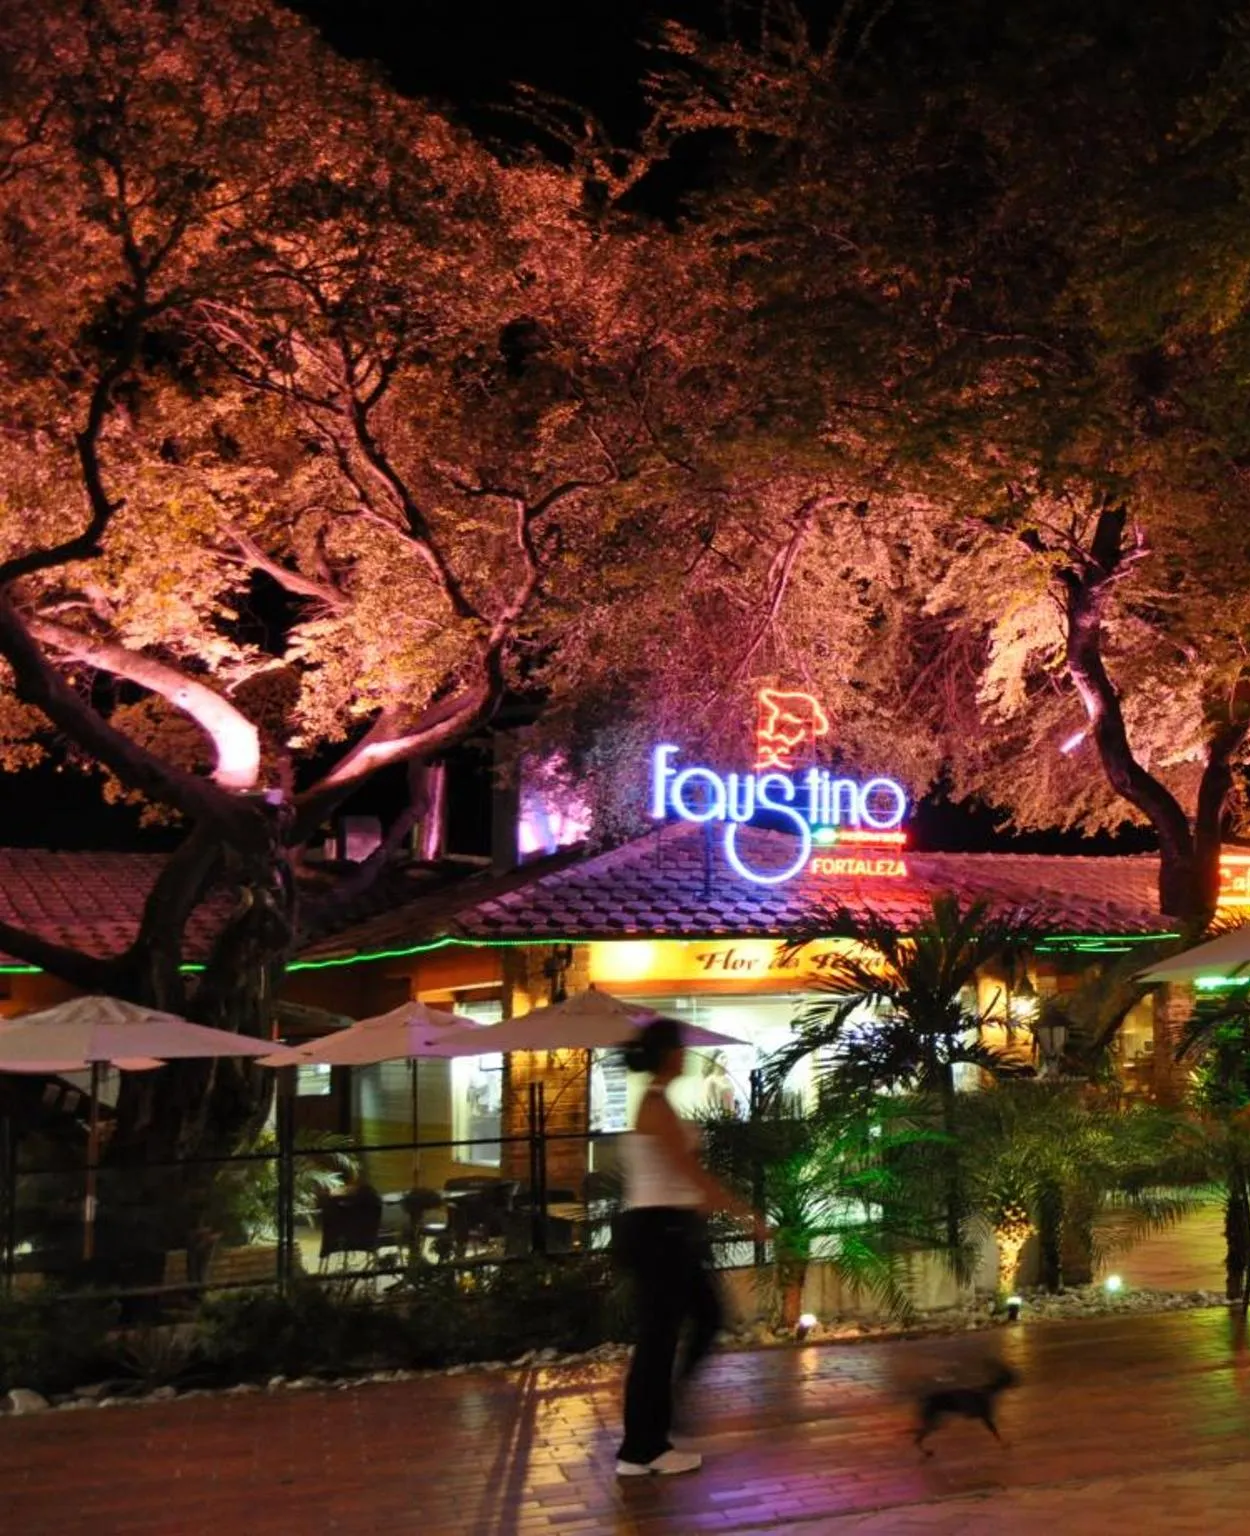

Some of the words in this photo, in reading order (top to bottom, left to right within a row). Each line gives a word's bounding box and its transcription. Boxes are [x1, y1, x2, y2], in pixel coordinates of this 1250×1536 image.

[652, 744, 907, 884] Faustino
[810, 858, 907, 877] FORTALEZA
[696, 948, 759, 971] Flor
